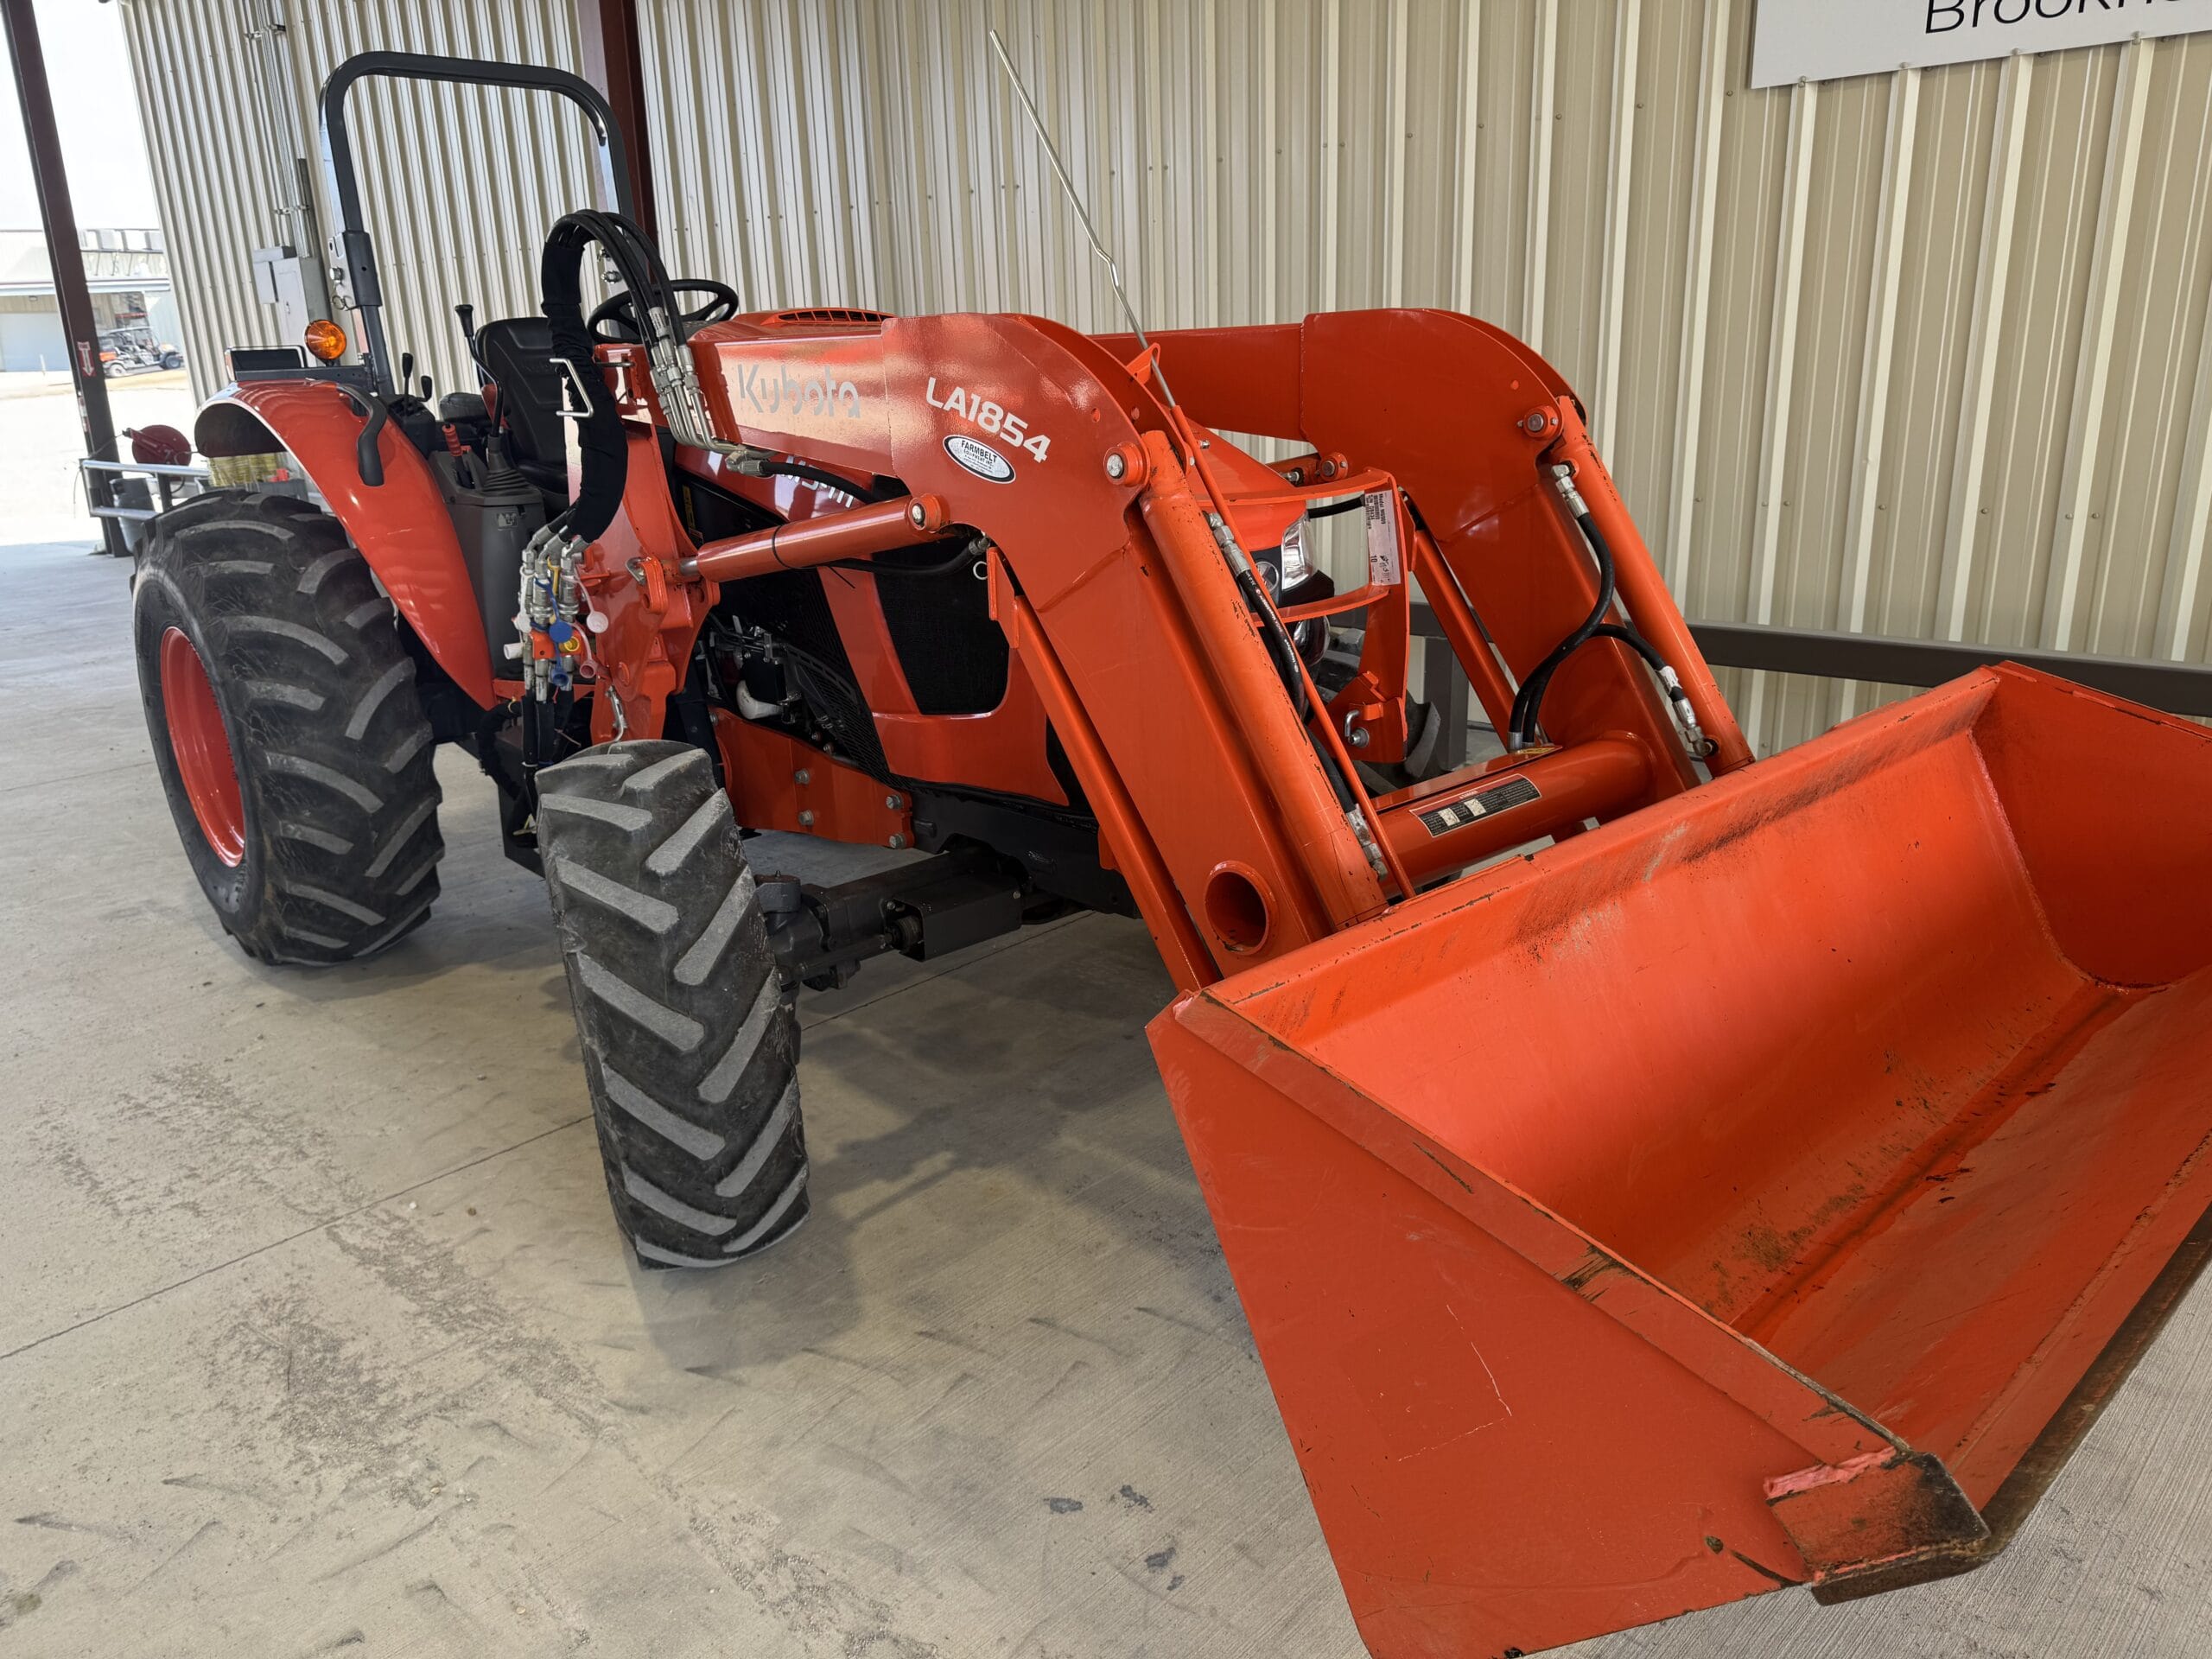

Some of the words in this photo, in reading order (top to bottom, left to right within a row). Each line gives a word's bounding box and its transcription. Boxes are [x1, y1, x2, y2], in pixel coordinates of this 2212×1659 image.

[737, 363, 861, 419] Kubota
[925, 377, 1052, 464] LA1854
[961, 440, 997, 463] FARMBELT
